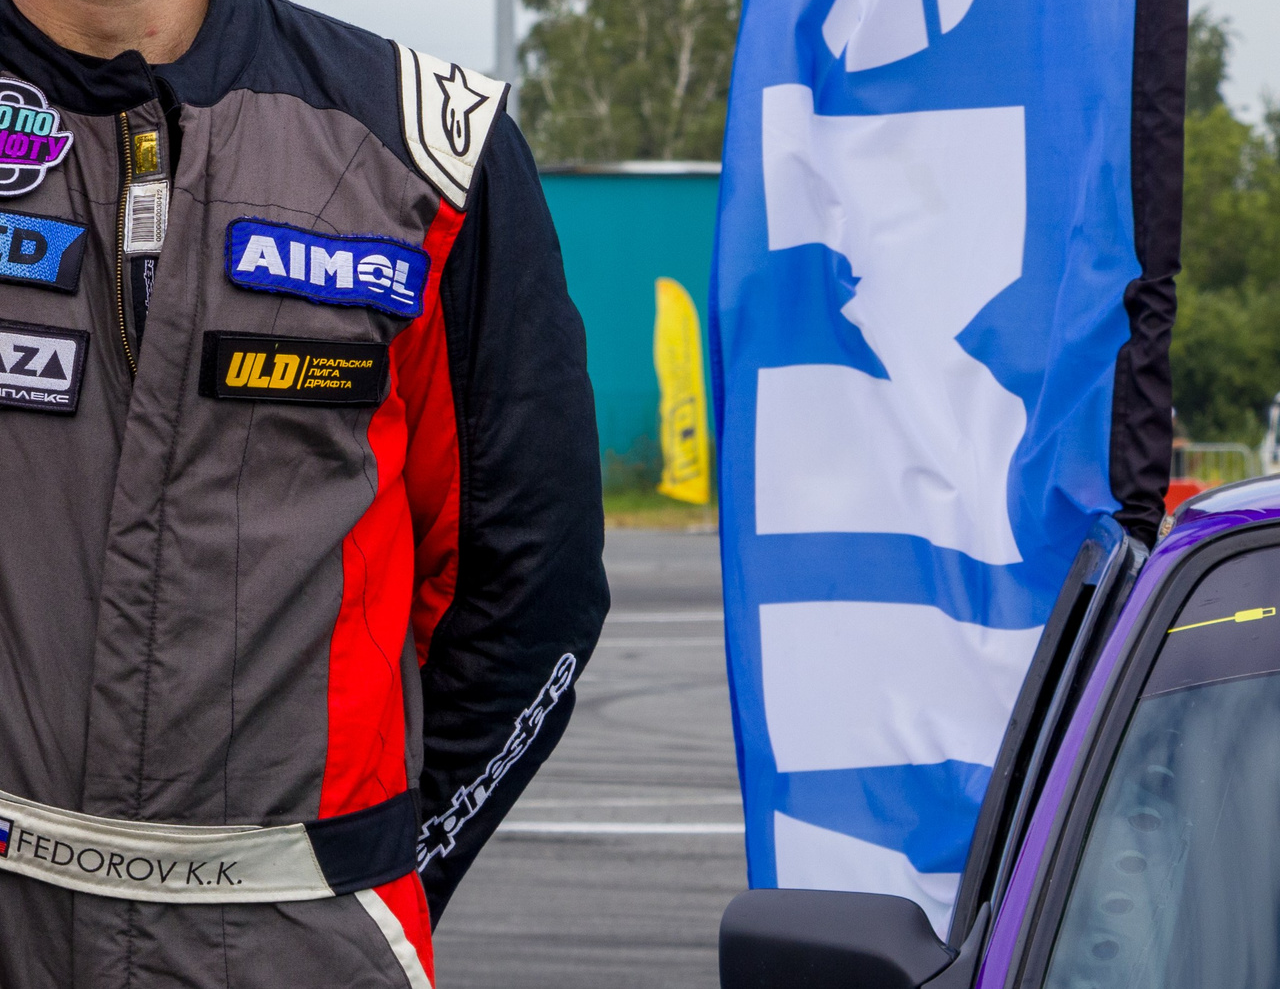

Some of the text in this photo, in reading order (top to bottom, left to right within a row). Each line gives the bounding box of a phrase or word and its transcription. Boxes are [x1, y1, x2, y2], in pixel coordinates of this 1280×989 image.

[16, 109, 53, 136] ПО
[236, 234, 416, 303] AIMOL
[225, 352, 300, 389] ULD
[308, 368, 340, 377] ЛИГА
[312, 358, 373, 368] УРАЛЬСКАЯ
[304, 378, 352, 389] ДРИФТА
[16, 829, 243, 886] FEDOROV K.K.
